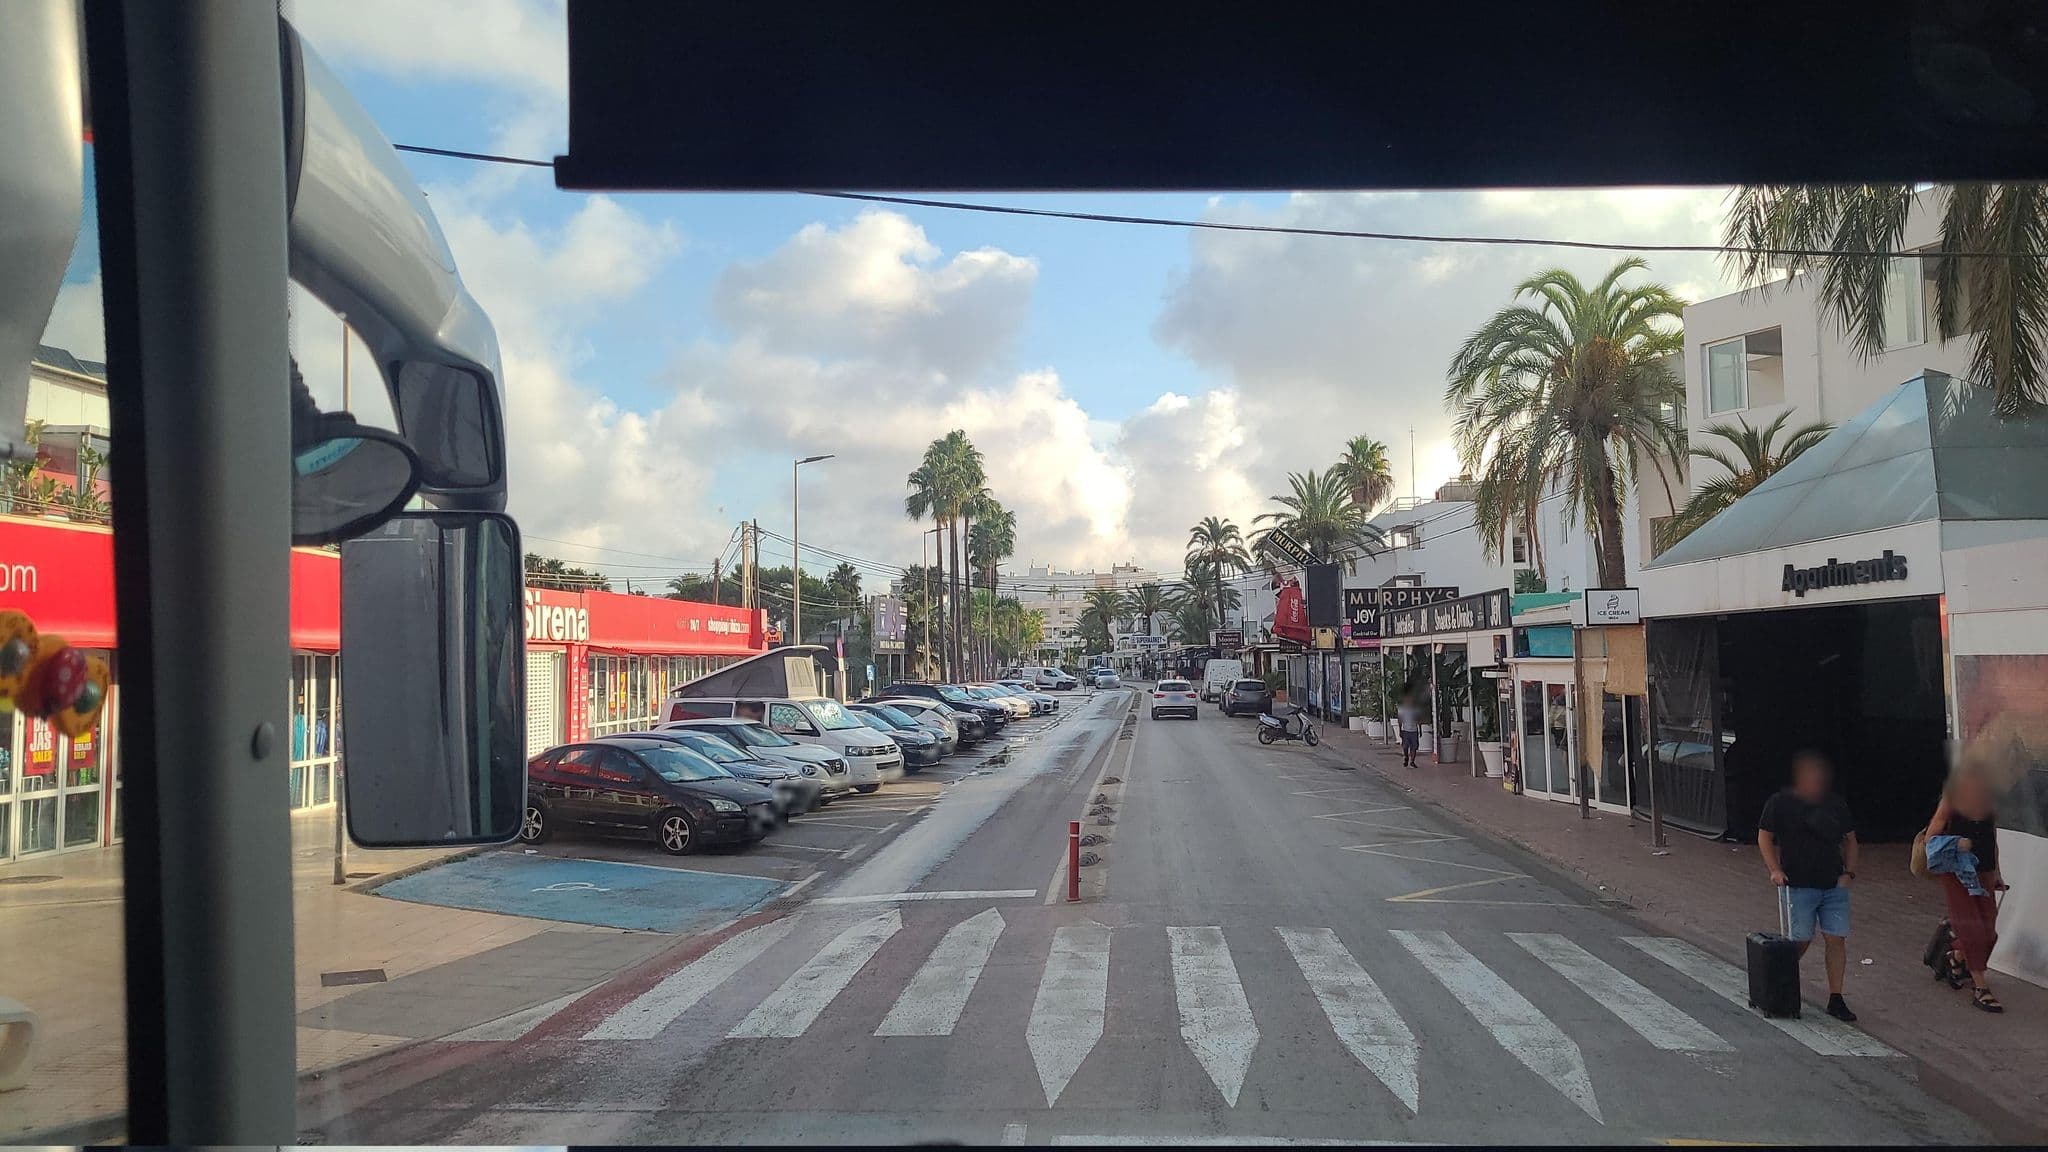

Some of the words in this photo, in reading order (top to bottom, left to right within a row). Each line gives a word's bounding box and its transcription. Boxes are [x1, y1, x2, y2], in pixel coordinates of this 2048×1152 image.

[1782, 550, 1908, 597] Apartments
[1350, 591, 1456, 606] MURPHY'S
[1490, 594, 1501, 626] JOY
[1353, 609, 1376, 624] JOY
[1451, 606, 1457, 629] &
[1456, 602, 1474, 628] Drinks
[30, 731, 52, 752] JAS
